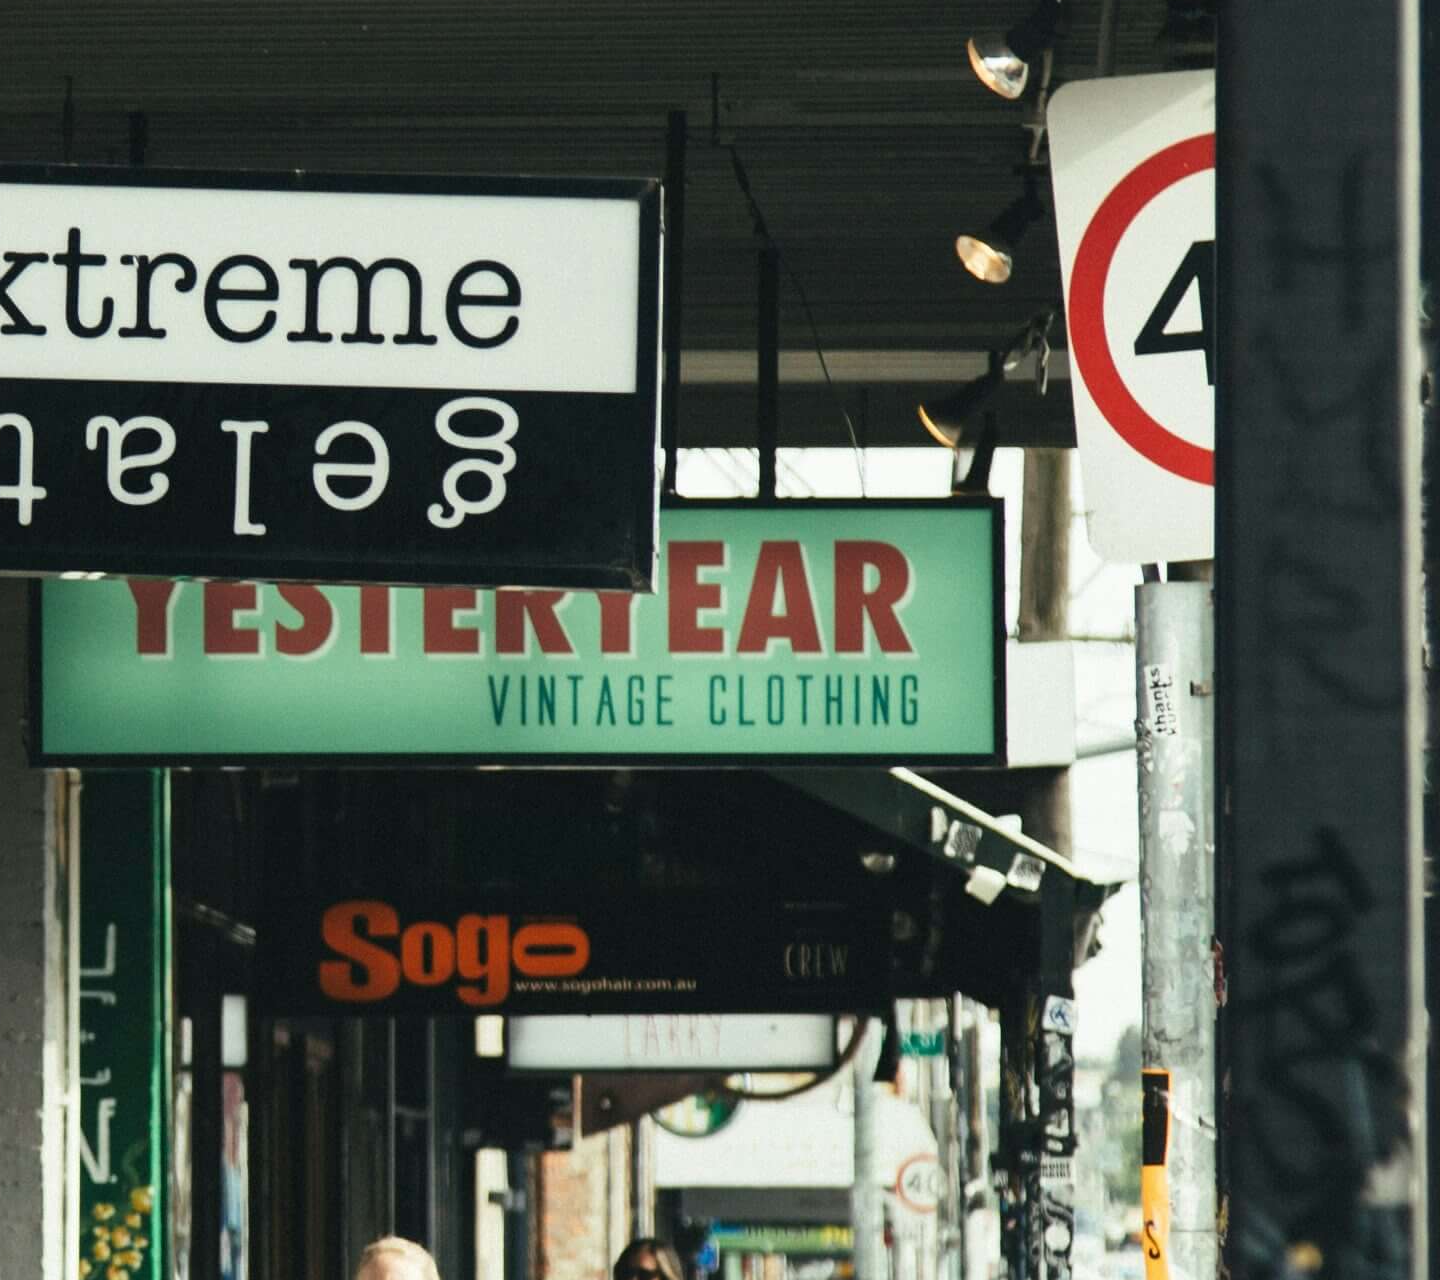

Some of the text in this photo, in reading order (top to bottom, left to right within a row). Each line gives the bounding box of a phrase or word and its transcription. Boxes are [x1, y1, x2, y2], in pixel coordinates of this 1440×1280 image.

[125, 539, 915, 658] YESTERYEAR
[489, 674, 921, 727] VINTAGE CLOTHING
[320, 899, 591, 1007] Sogo
[784, 943, 849, 977] CREW
[514, 977, 698, 997] www.sogohair.com.au
